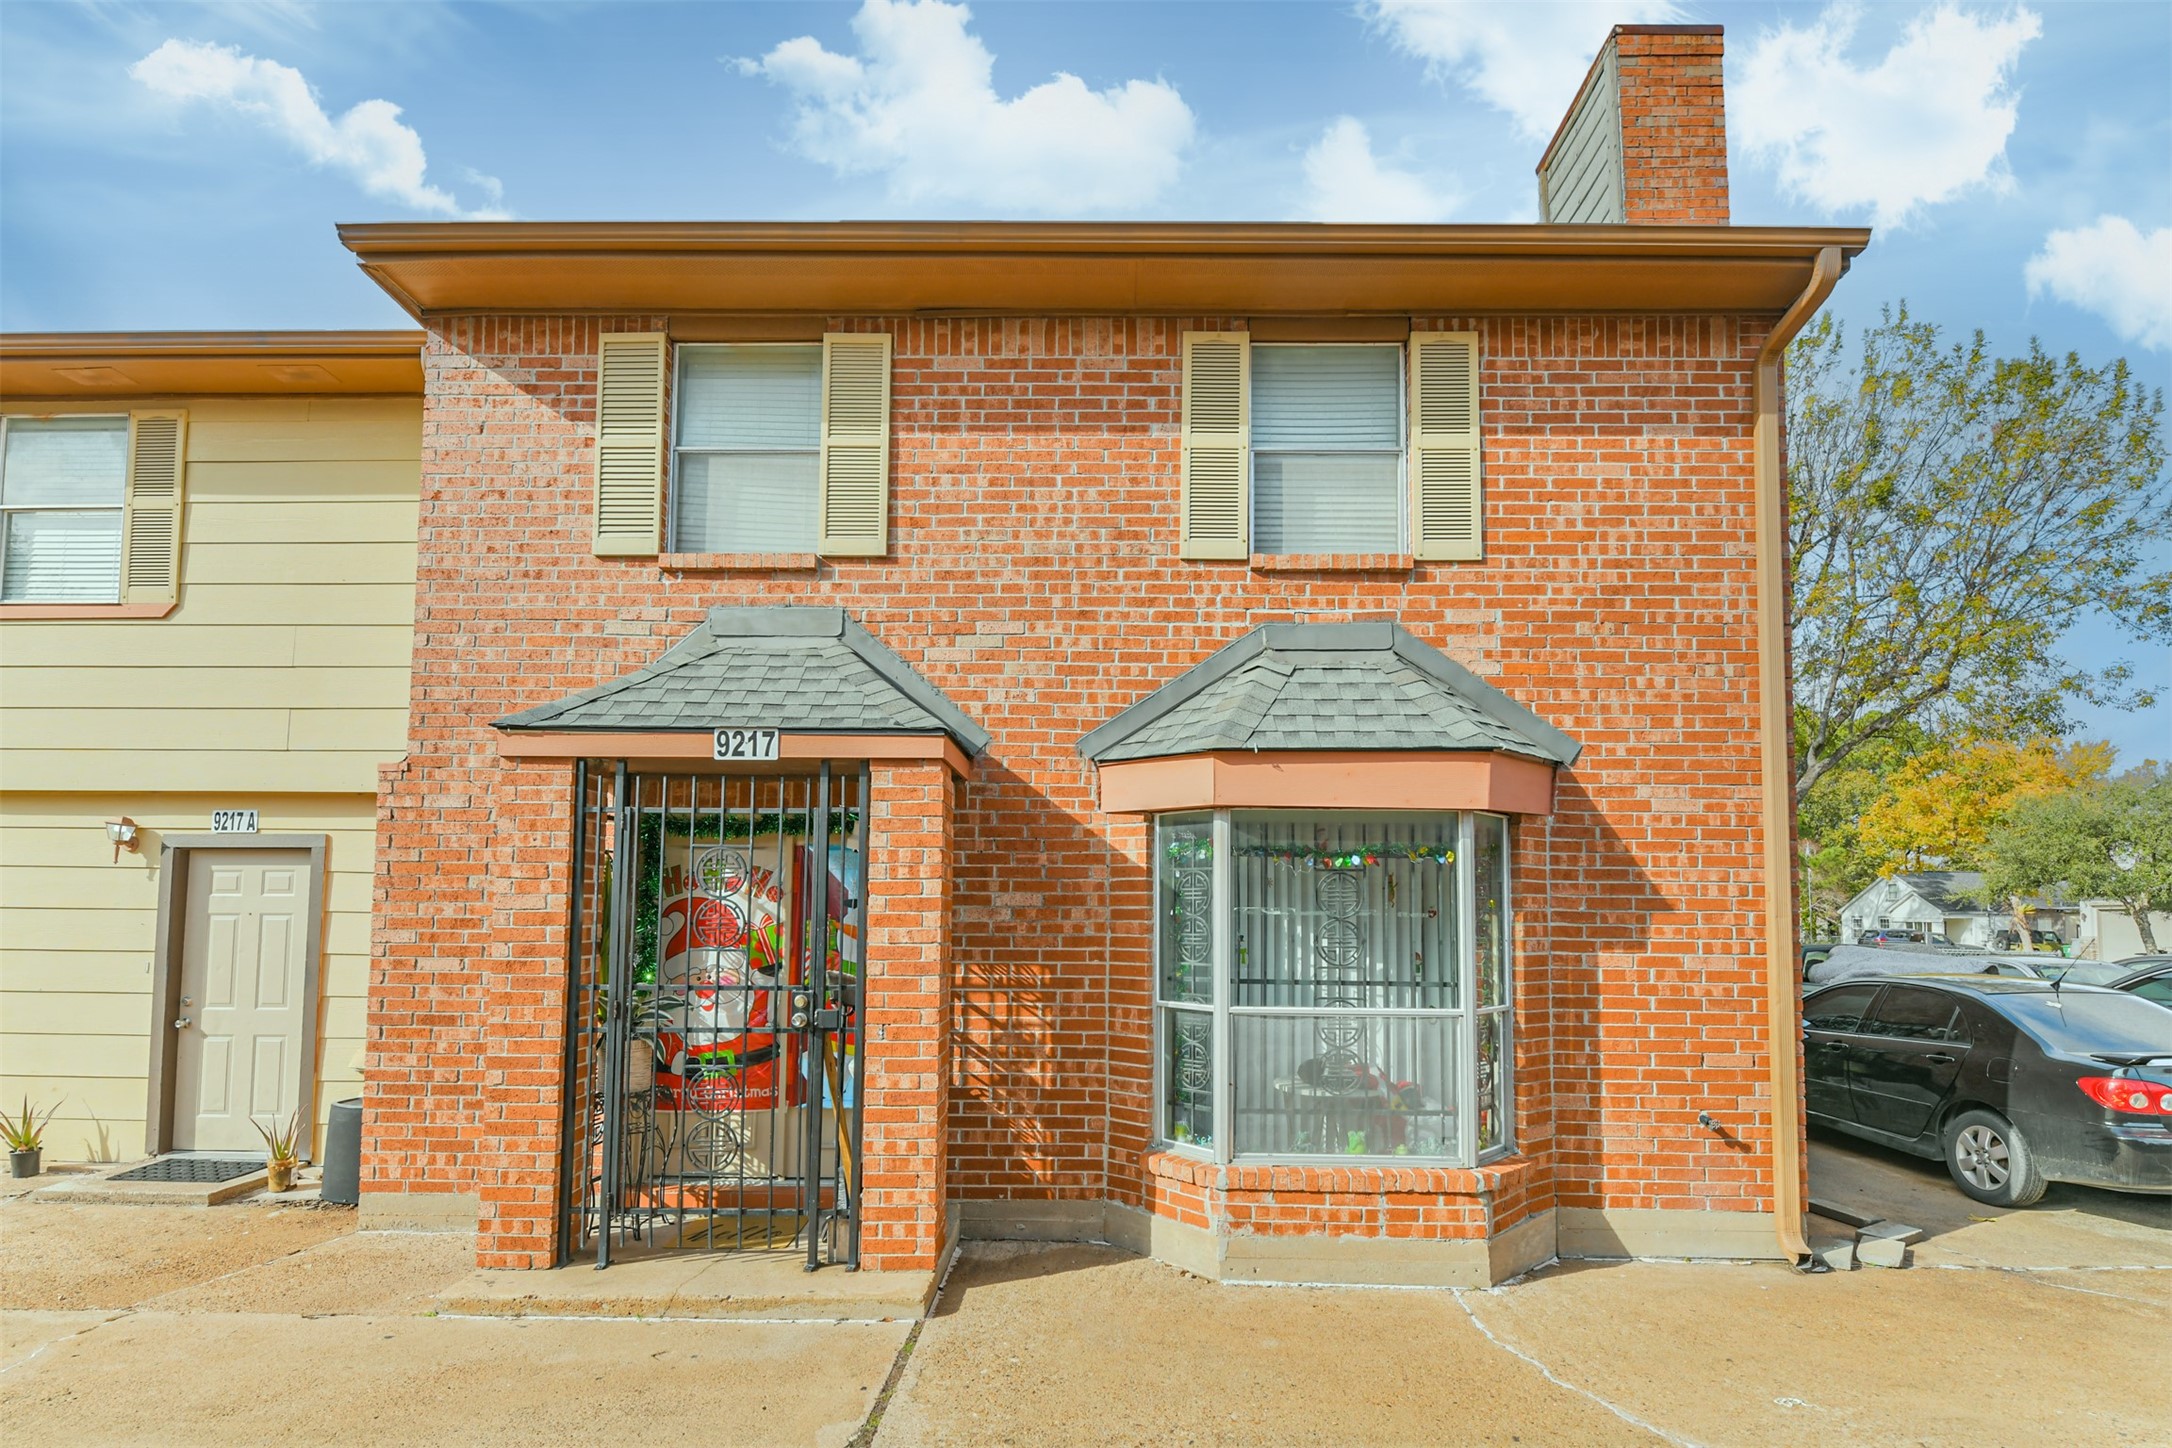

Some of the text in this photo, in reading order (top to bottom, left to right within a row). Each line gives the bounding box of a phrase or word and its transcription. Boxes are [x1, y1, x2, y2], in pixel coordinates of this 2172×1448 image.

[716, 730, 776, 757] 9217
[214, 811, 256, 831] 9217 A
